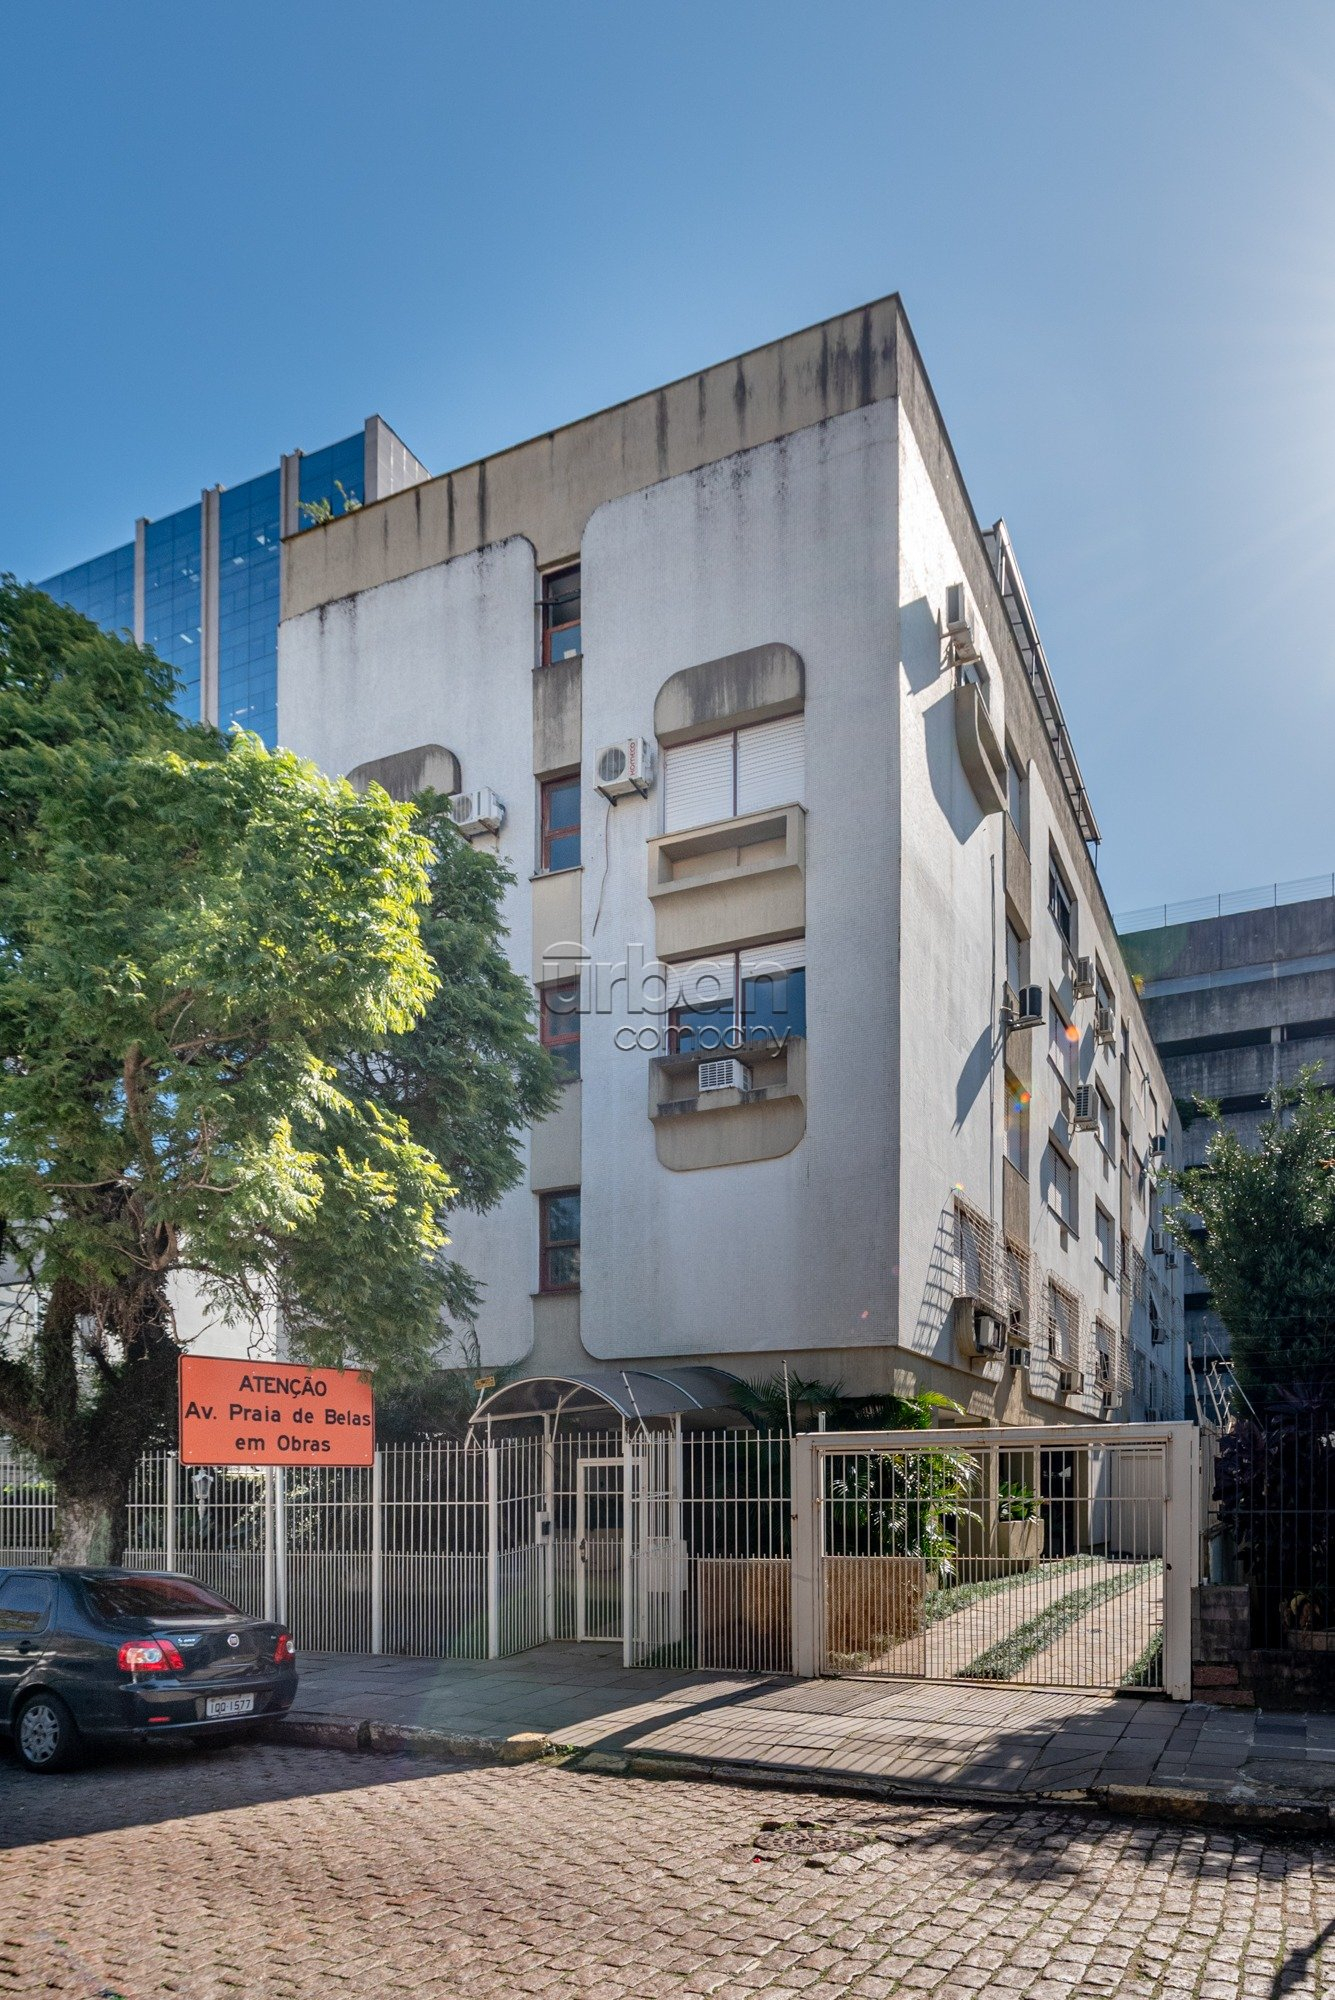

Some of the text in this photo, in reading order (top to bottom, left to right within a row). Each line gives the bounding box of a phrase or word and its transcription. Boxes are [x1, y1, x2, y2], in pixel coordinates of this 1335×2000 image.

[239, 1375, 327, 1399] ATENÇÃO
[185, 1402, 371, 1426] Av. Praia de Belas
[235, 1435, 331, 1452] em Obras
